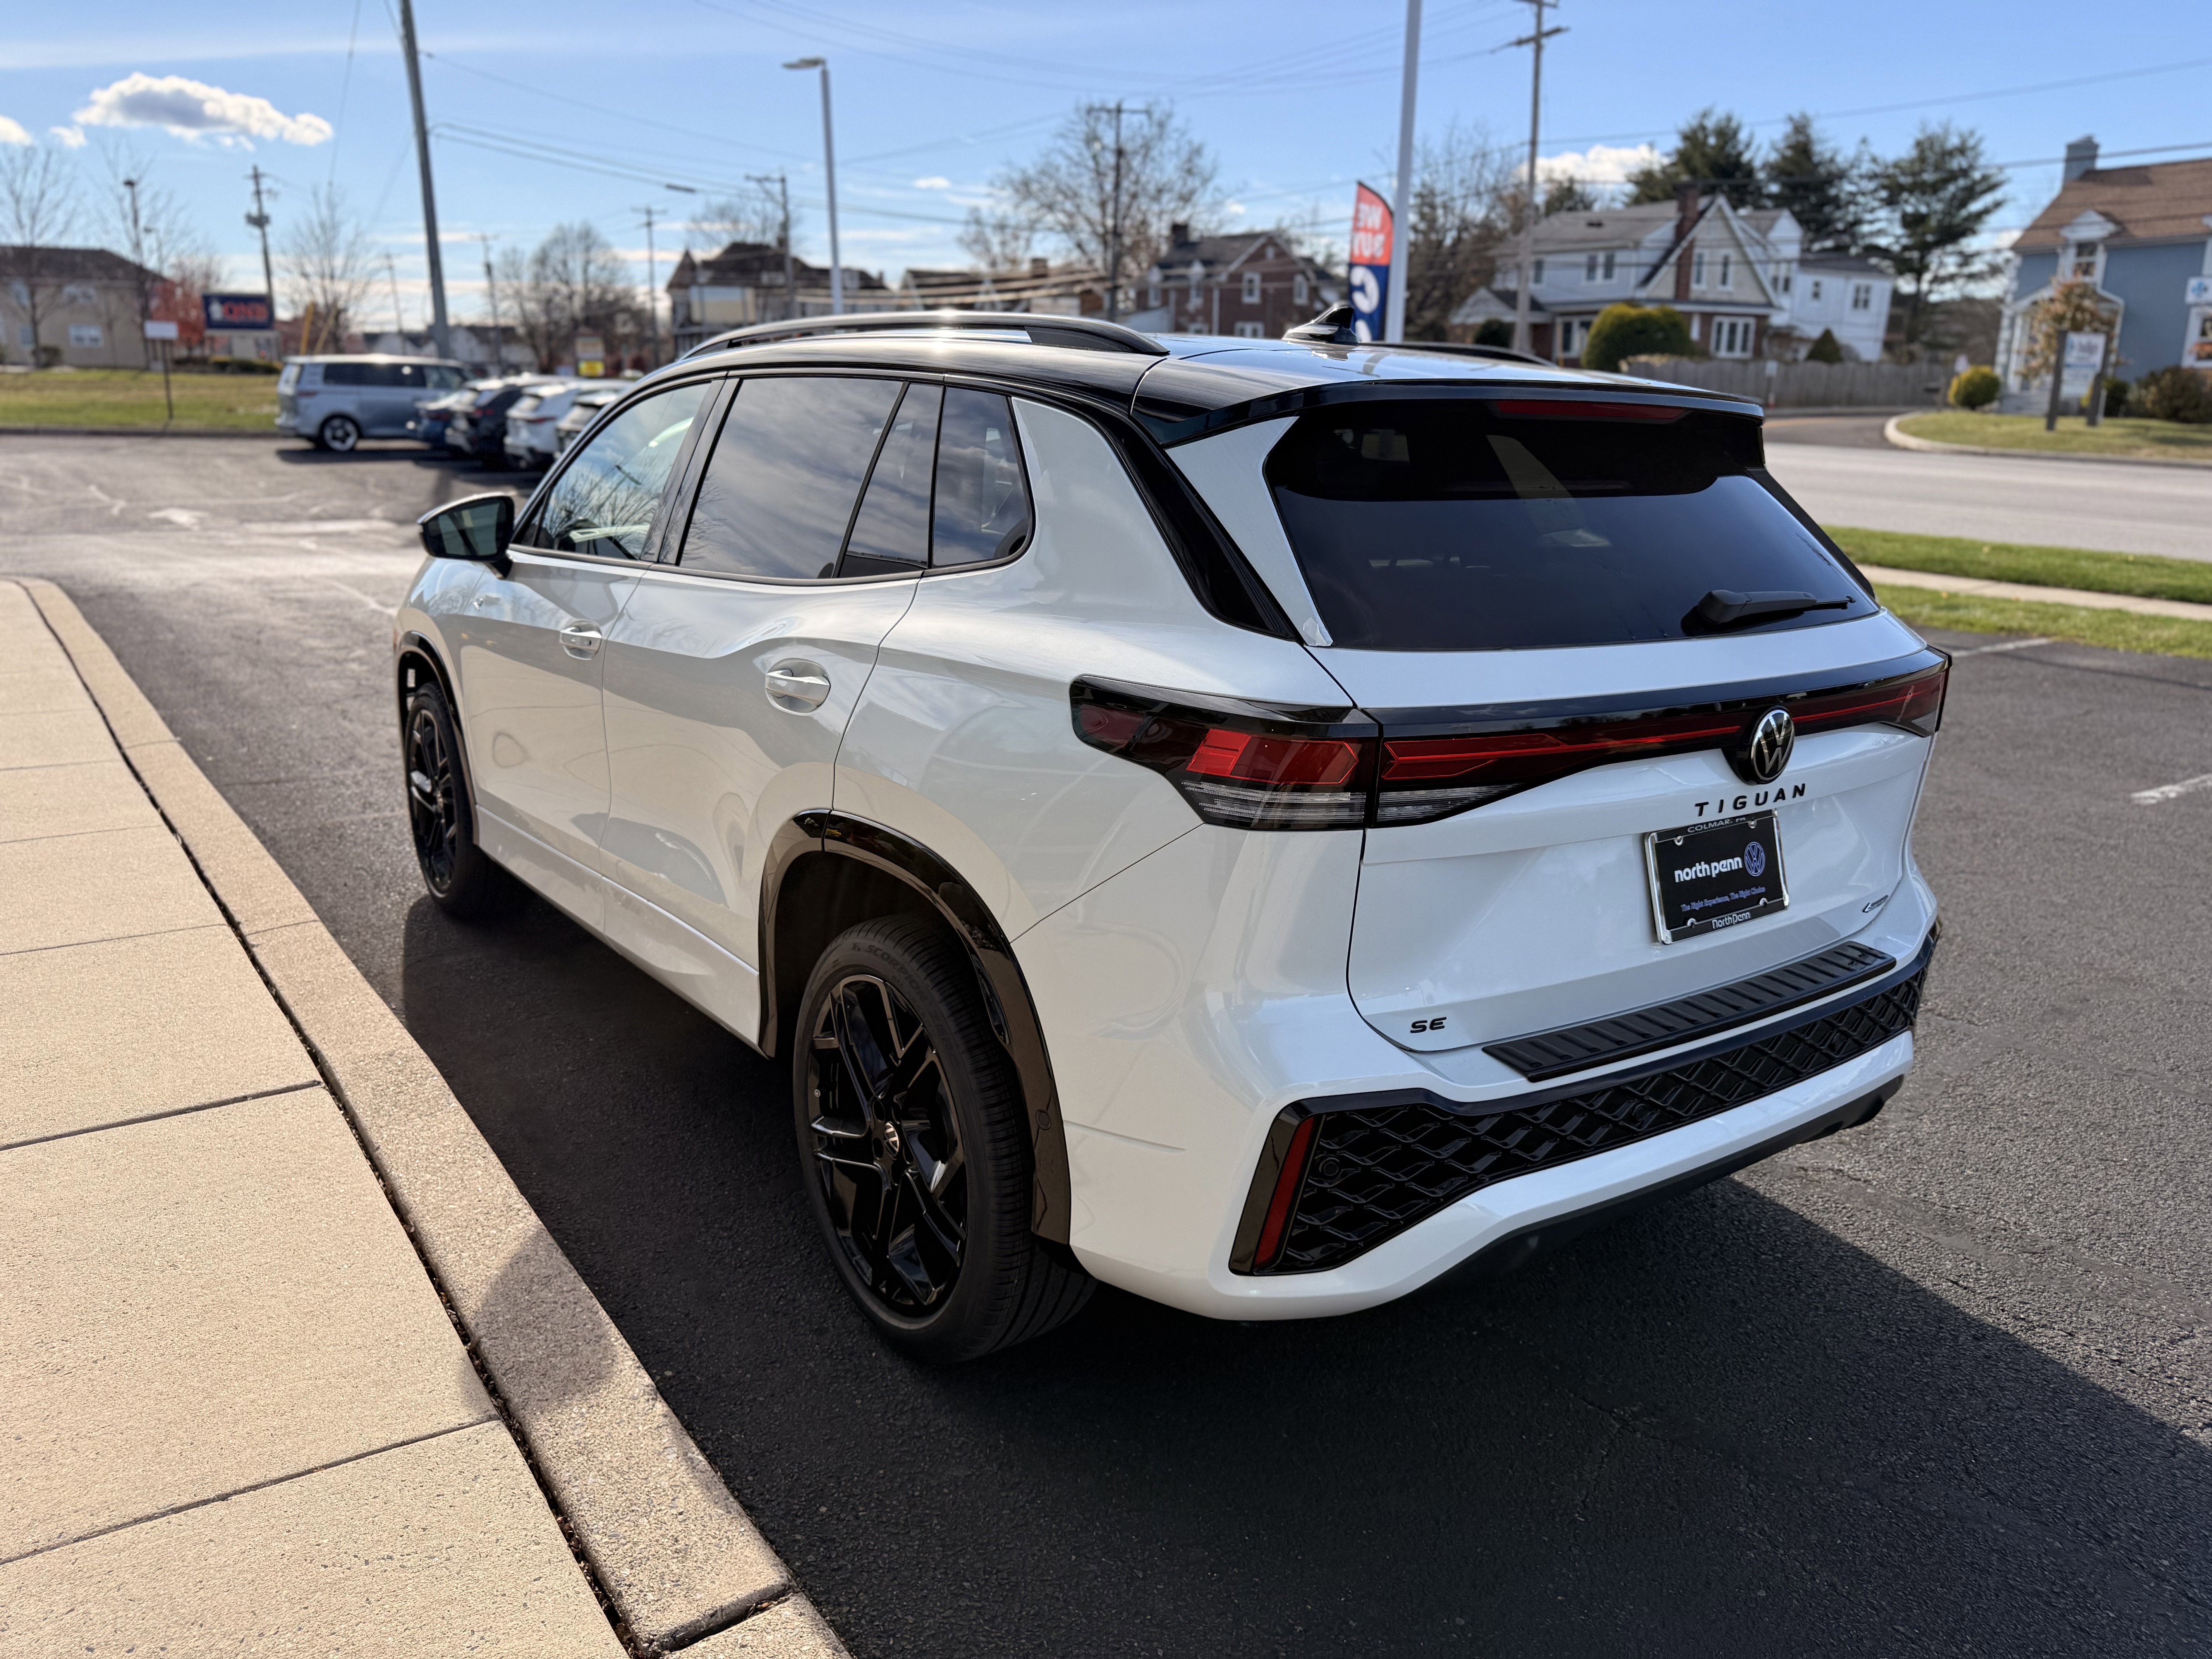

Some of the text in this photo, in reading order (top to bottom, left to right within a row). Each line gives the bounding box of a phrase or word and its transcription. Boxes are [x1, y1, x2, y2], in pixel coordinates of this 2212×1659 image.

[1695, 783, 1805, 817] TIGUAN
[865, 945, 928, 1003] SCORPION
[1410, 1017, 1447, 1034] SE
